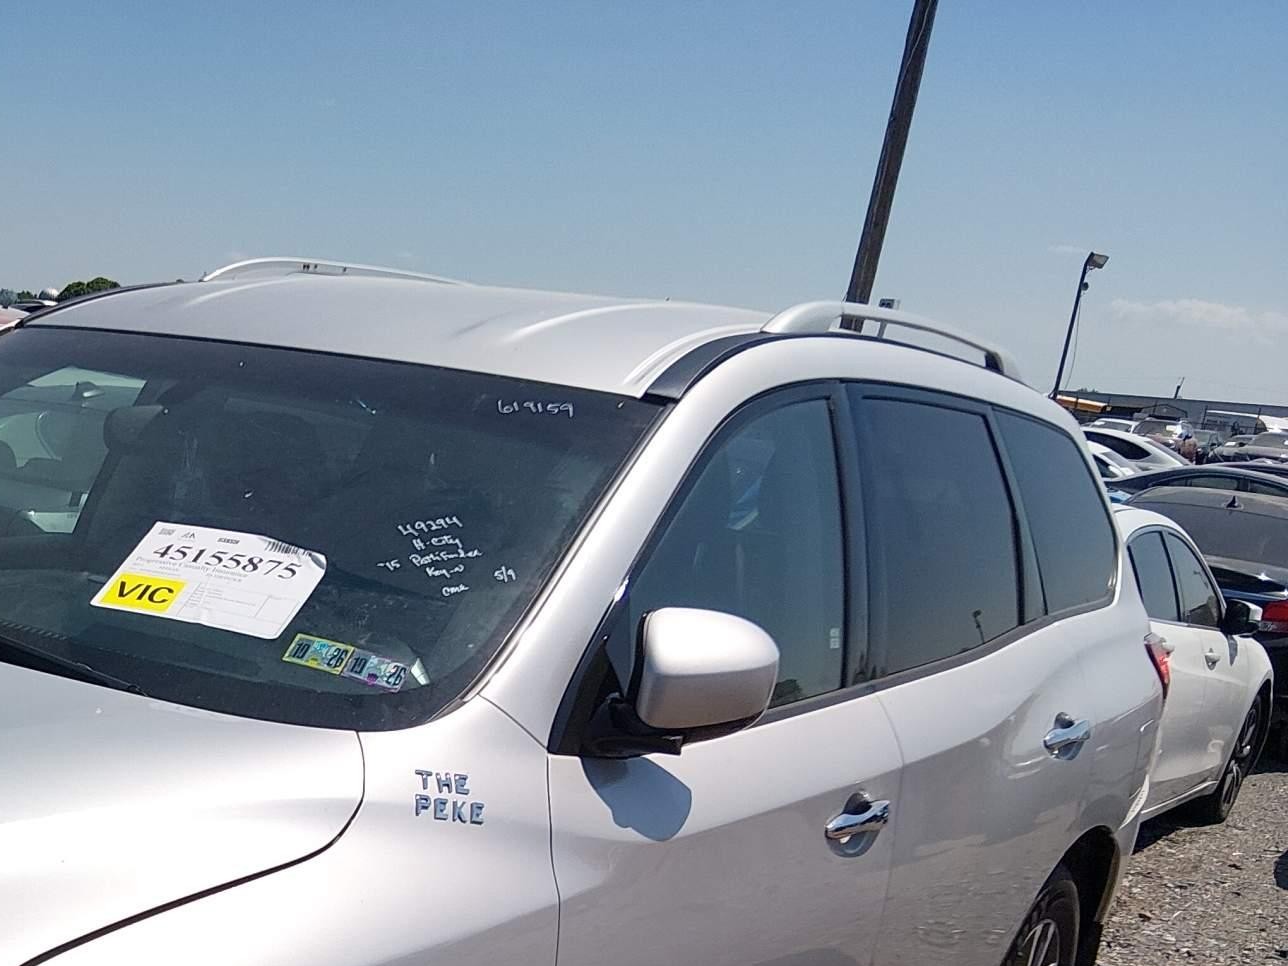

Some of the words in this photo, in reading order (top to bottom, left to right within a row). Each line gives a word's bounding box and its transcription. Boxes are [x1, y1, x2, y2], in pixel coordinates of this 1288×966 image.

[497, 399, 574, 418] 619159
[152, 543, 303, 580] 45155875
[493, 565, 517, 583] 5/9
[118, 580, 175, 604] VIC
[292, 642, 311, 660] 10
[327, 647, 349, 669] 26
[349, 656, 368, 675] 10
[385, 664, 407, 687] 26
[415, 769, 470, 795] THE
[415, 793, 485, 826] PEKE
